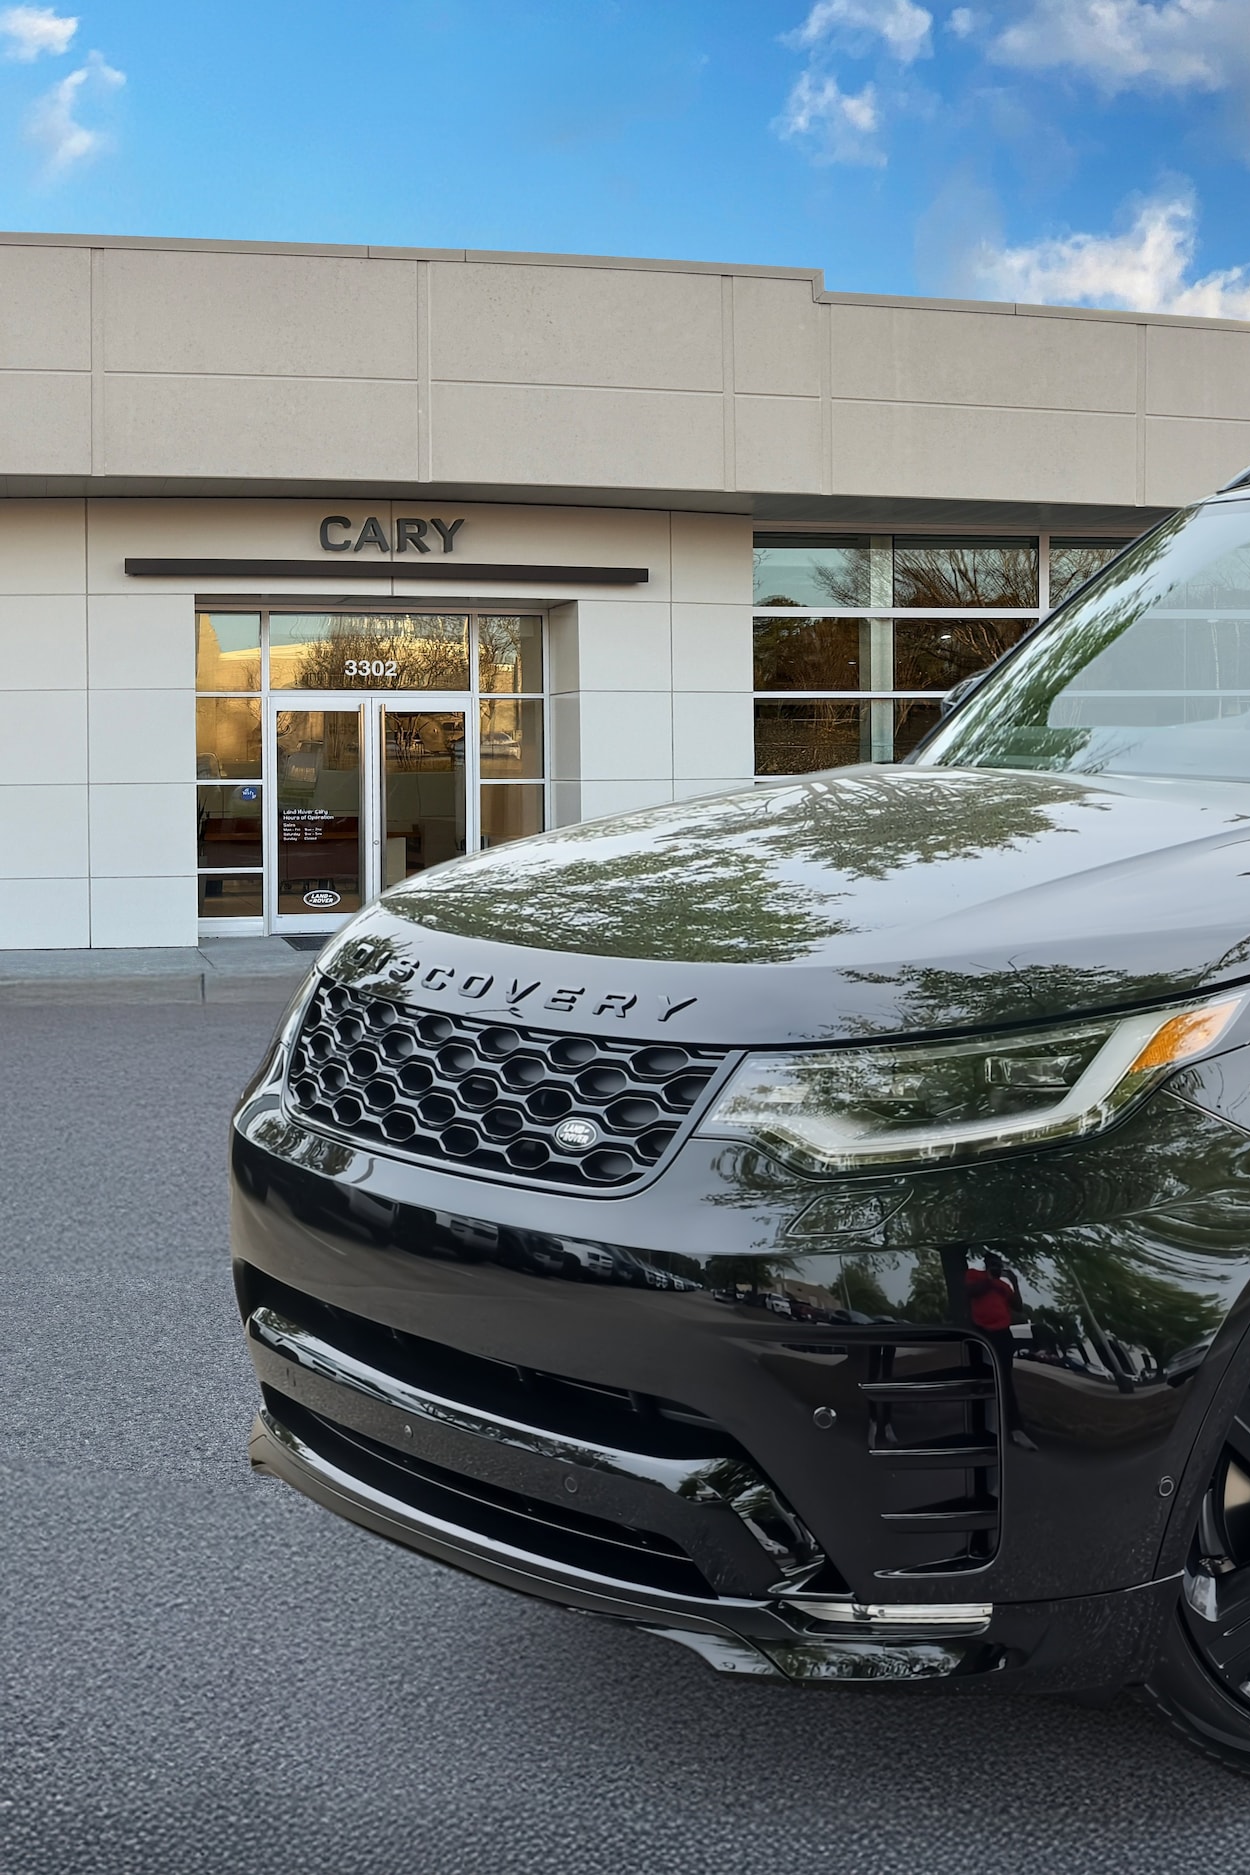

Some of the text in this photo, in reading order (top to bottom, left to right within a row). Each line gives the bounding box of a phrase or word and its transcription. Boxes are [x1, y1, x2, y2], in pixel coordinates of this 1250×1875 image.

[319, 515, 465, 553] CARY
[344, 660, 398, 677] 3302
[352, 942, 698, 1023] DISCOVERY
